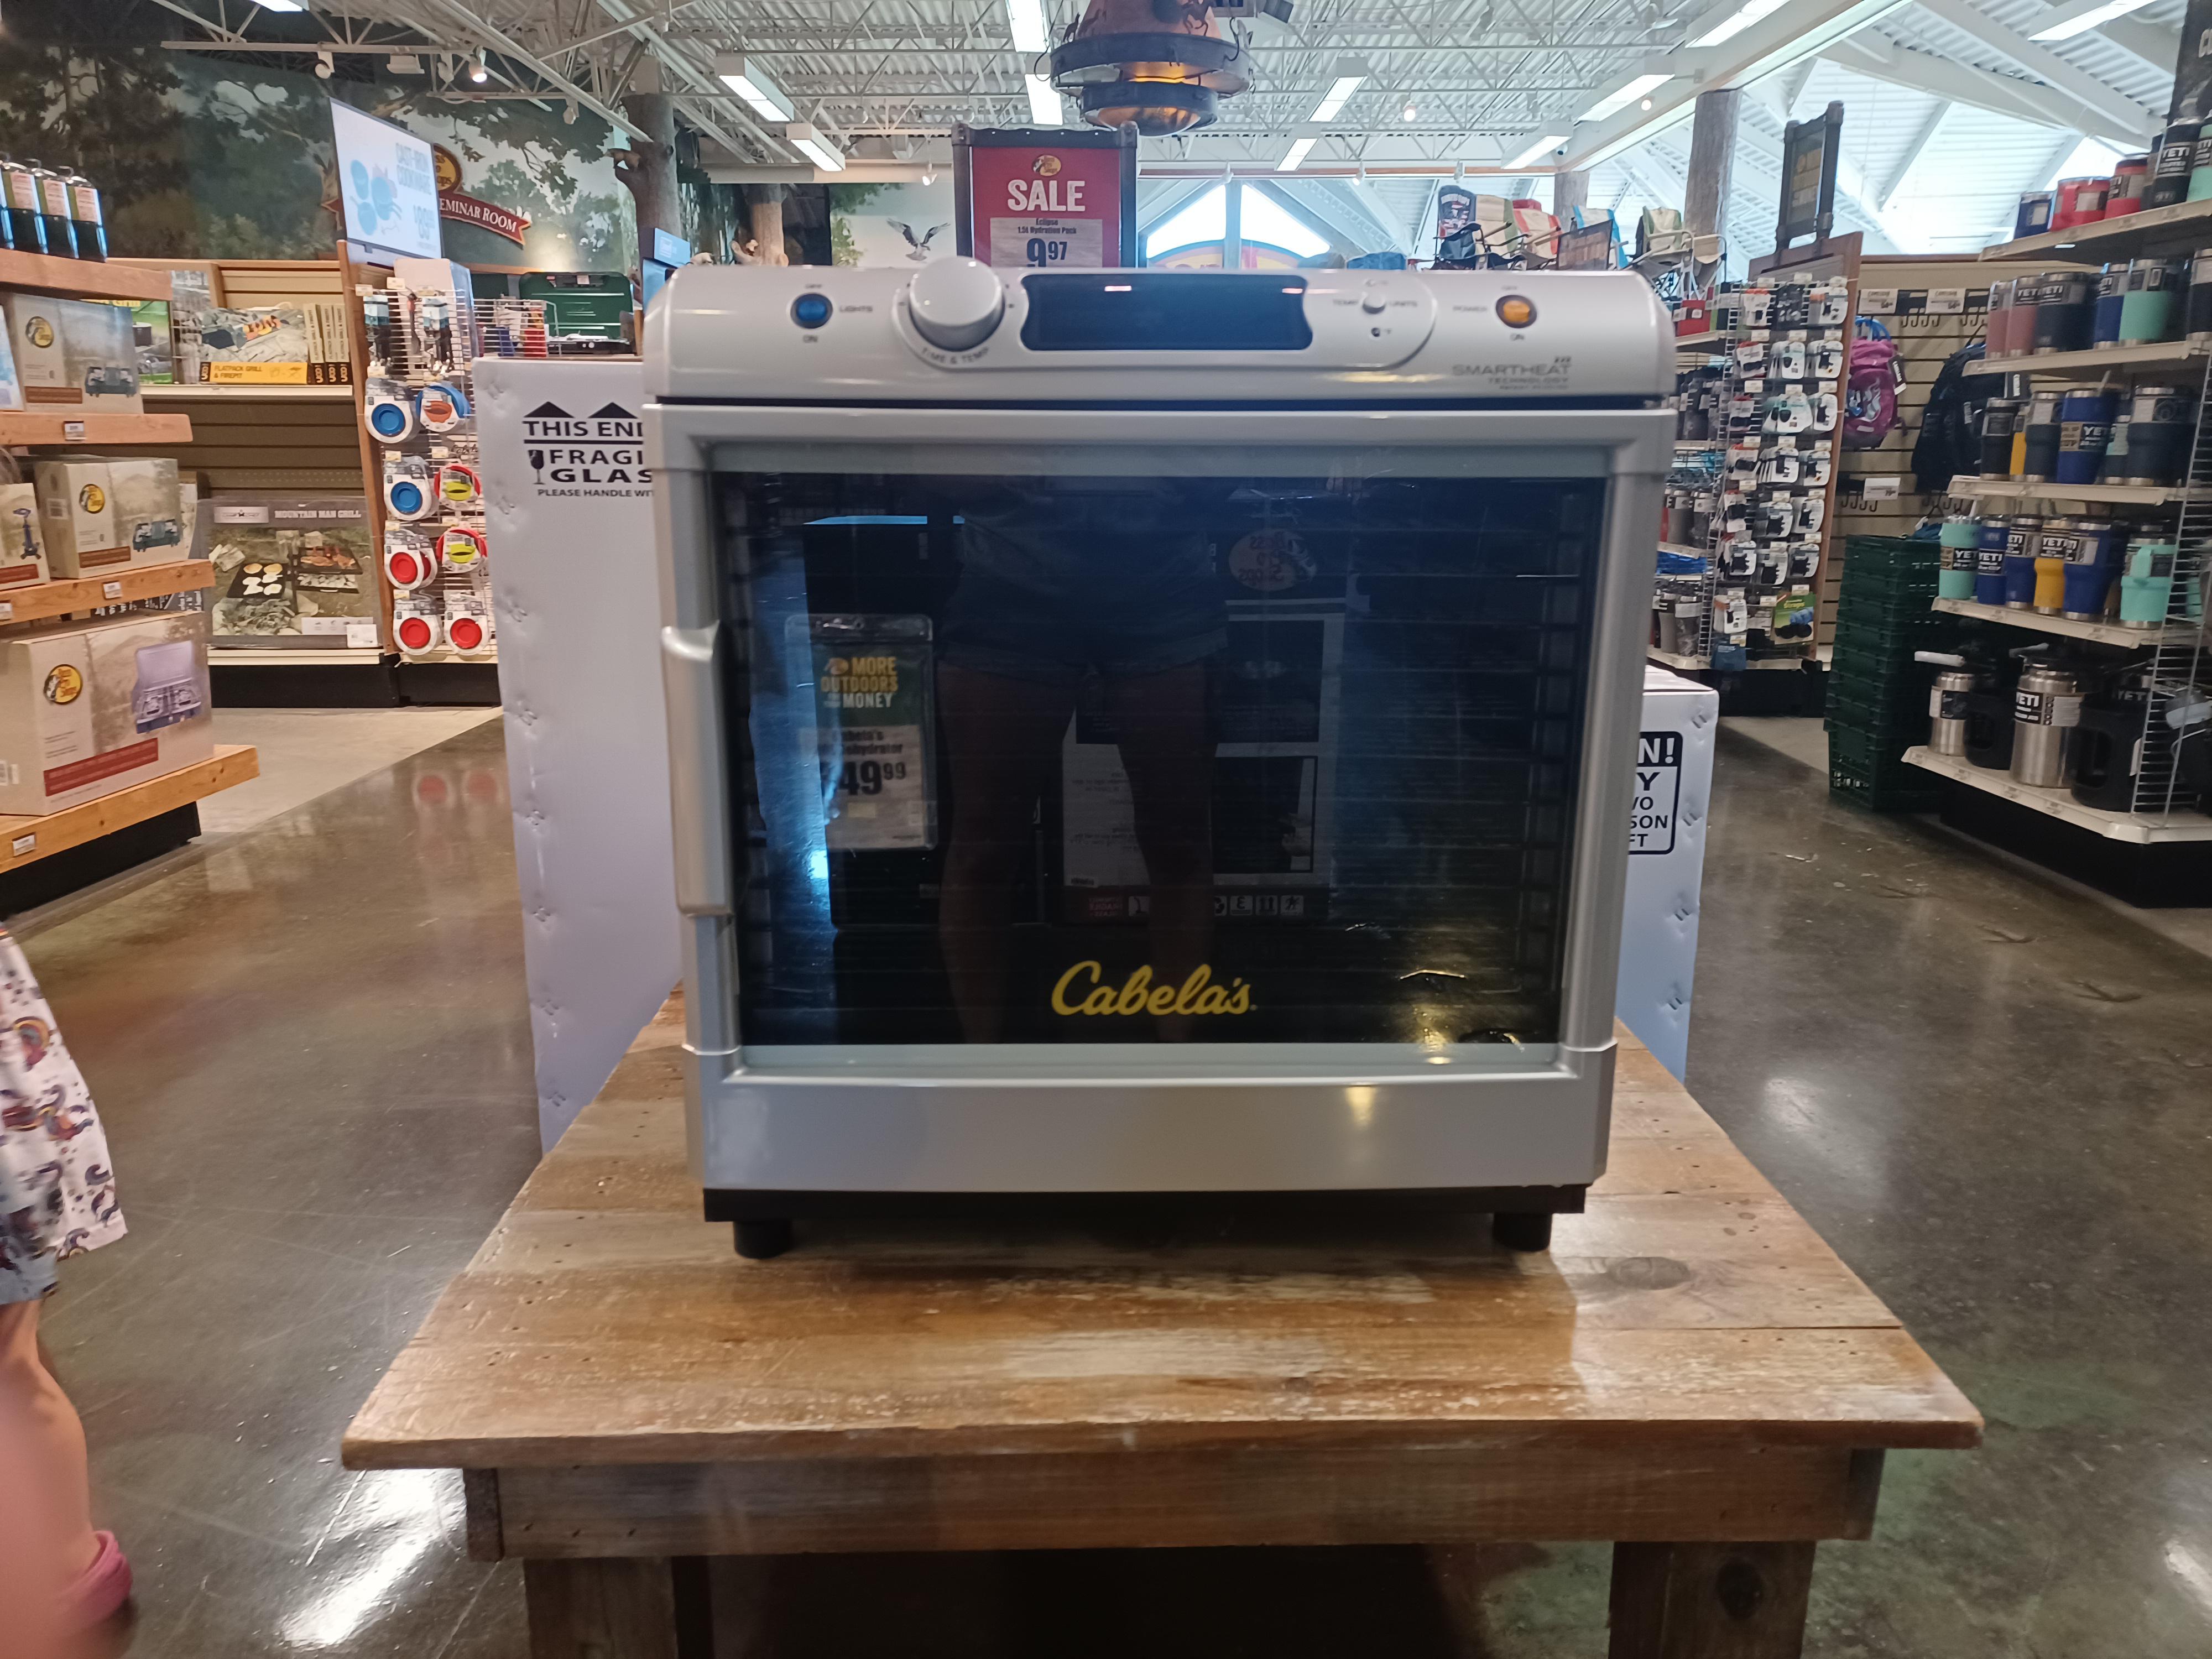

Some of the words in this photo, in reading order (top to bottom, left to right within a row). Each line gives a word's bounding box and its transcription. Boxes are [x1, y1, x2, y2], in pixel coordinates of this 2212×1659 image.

[1008, 179, 1086, 211] SALE
[439, 198, 481, 219] EMINAR
[483, 208, 517, 232] ROOM
[1452, 363, 1568, 376] SMARTHEAT
[522, 421, 588, 436] THIS
[598, 422, 643, 437] EN
[550, 449, 643, 465] FRAGI
[550, 468, 653, 483] GLAS
[852, 657, 897, 676] MORE
[821, 675, 898, 692] OUTDOORS
[843, 693, 893, 708] MONEY
[1636, 772, 1660, 791] Y
[1051, 960, 1251, 1016] Cabela's
